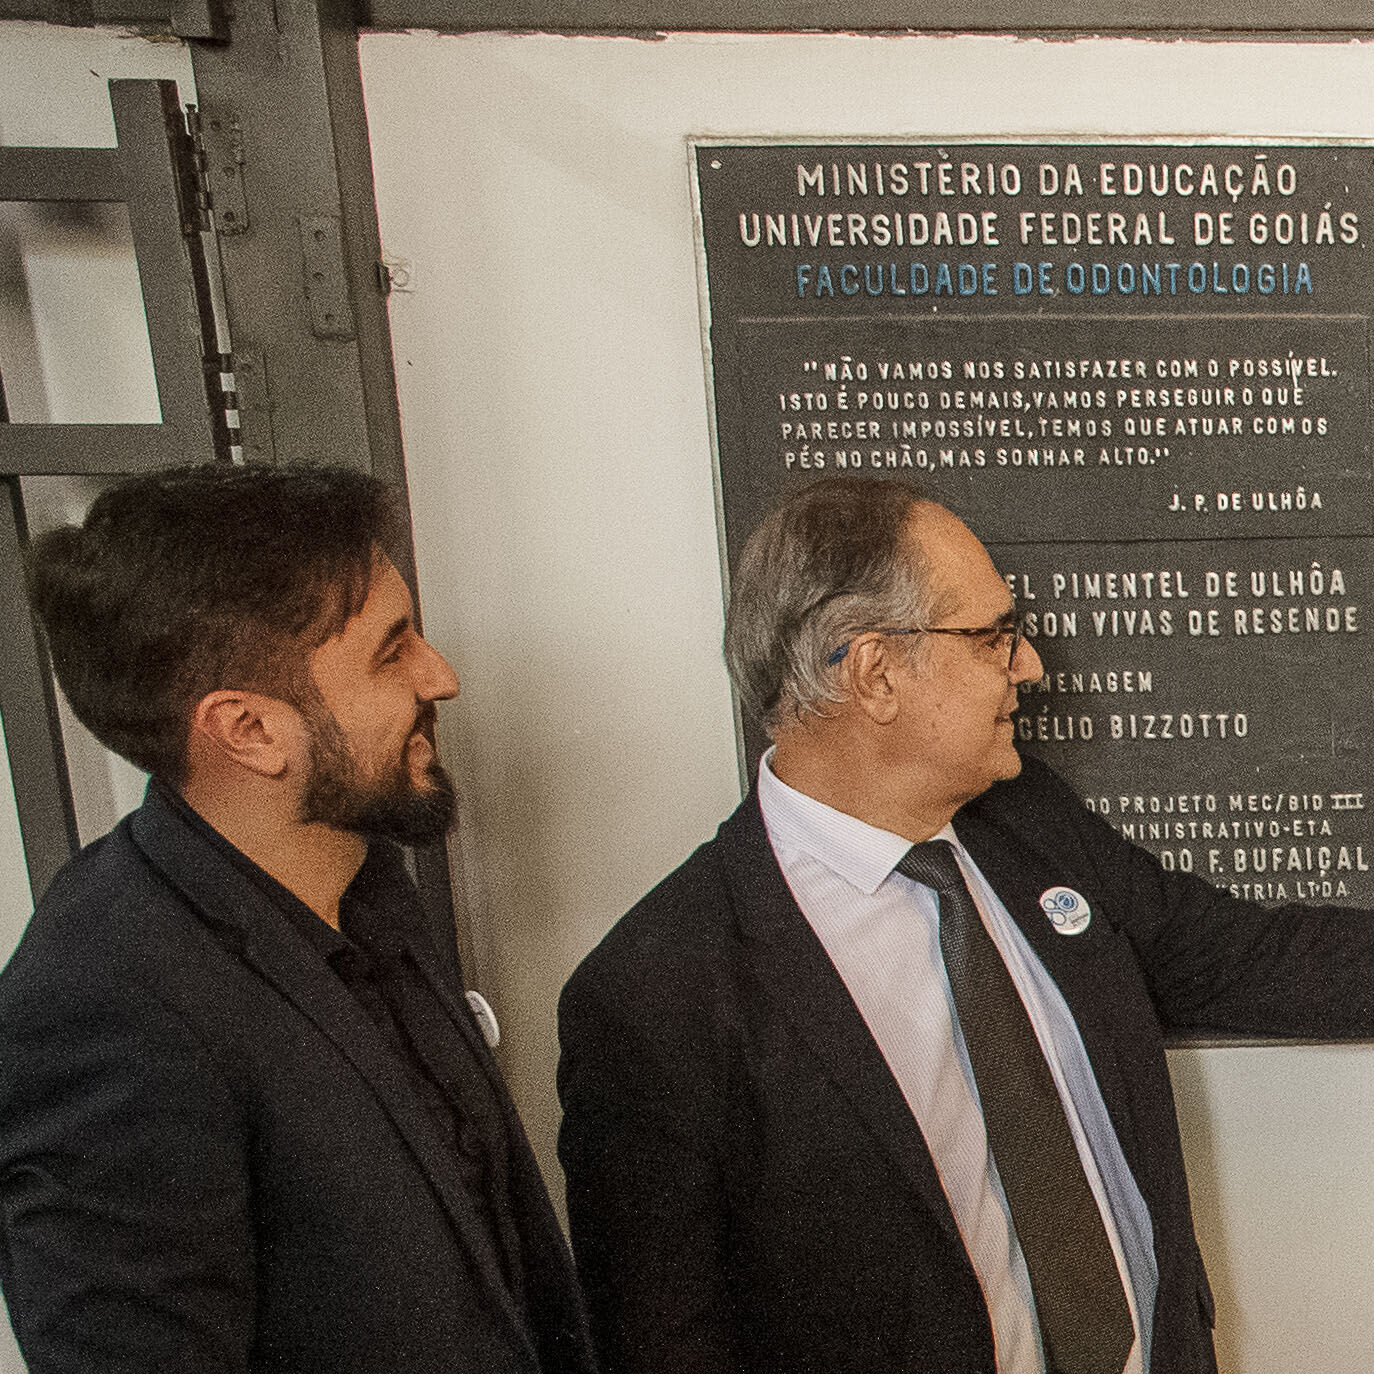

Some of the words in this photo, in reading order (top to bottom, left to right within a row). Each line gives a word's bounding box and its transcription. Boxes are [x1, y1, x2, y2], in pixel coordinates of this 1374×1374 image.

[1039, 162, 1083, 197] DA
[1099, 154, 1297, 203] EDUCAÇÃO
[739, 212, 1000, 247] UNIVERSIDADE
[1019, 211, 1175, 246] FEDERAL
[1194, 211, 1234, 246] DE
[1249, 201, 1359, 245] GOIÁS
[797, 262, 999, 297] FACULDADE
[1013, 262, 1053, 296] DE
[1066, 261, 1313, 296] ODONTOLOGIA
[877, 360, 952, 380] VAMOS
[963, 360, 1005, 379] NOS
[1013, 360, 1147, 379] SATISFAZER
[1156, 359, 1198, 378] COM
[1208, 358, 1219, 378] O
[779, 392, 828, 411] ISTO
[837, 383, 848, 410] É
[857, 391, 929, 410] POUCO
[1117, 387, 1235, 408] PERSEGUIR
[1242, 388, 1253, 406] O
[1262, 387, 1304, 406] QUE
[781, 420, 880, 440] PARECER
[1124, 417, 1167, 437] QUE
[1175, 417, 1243, 436] ATUAR
[785, 444, 825, 469] PÉS
[835, 450, 862, 468] NO
[996, 448, 1085, 467] SONHAR
[1168, 493, 1186, 511] J.
[1195, 494, 1208, 512] P.
[1217, 491, 1242, 511] DE
[1251, 486, 1322, 511] ULHÔA
[1005, 572, 1036, 600] EL
[1053, 571, 1189, 600] PIMENTEL
[1206, 570, 1238, 598] DE
[1250, 561, 1346, 598] ULHÔA
[1025, 610, 1077, 638] SON
[1092, 609, 1173, 638] VIVAS
[1188, 608, 1221, 637] DE
[1234, 606, 1359, 636] RESENDE
[1020, 671, 1153, 694] OMENAGEM
[1018, 704, 1094, 741] GÉLIO
[1110, 713, 1248, 741] BIZZOTTO
[1119, 794, 1216, 814] PROJETO
[1229, 793, 1323, 813] MEC/BID
[1330, 792, 1365, 811] III
[1113, 818, 1333, 841] MINISTRATIVO-ETA
[1161, 848, 1193, 873] DO
[1208, 849, 1224, 873] F.
[1233, 846, 1370, 877] BUFAIÇAL
[1216, 881, 1287, 900] STRIA
